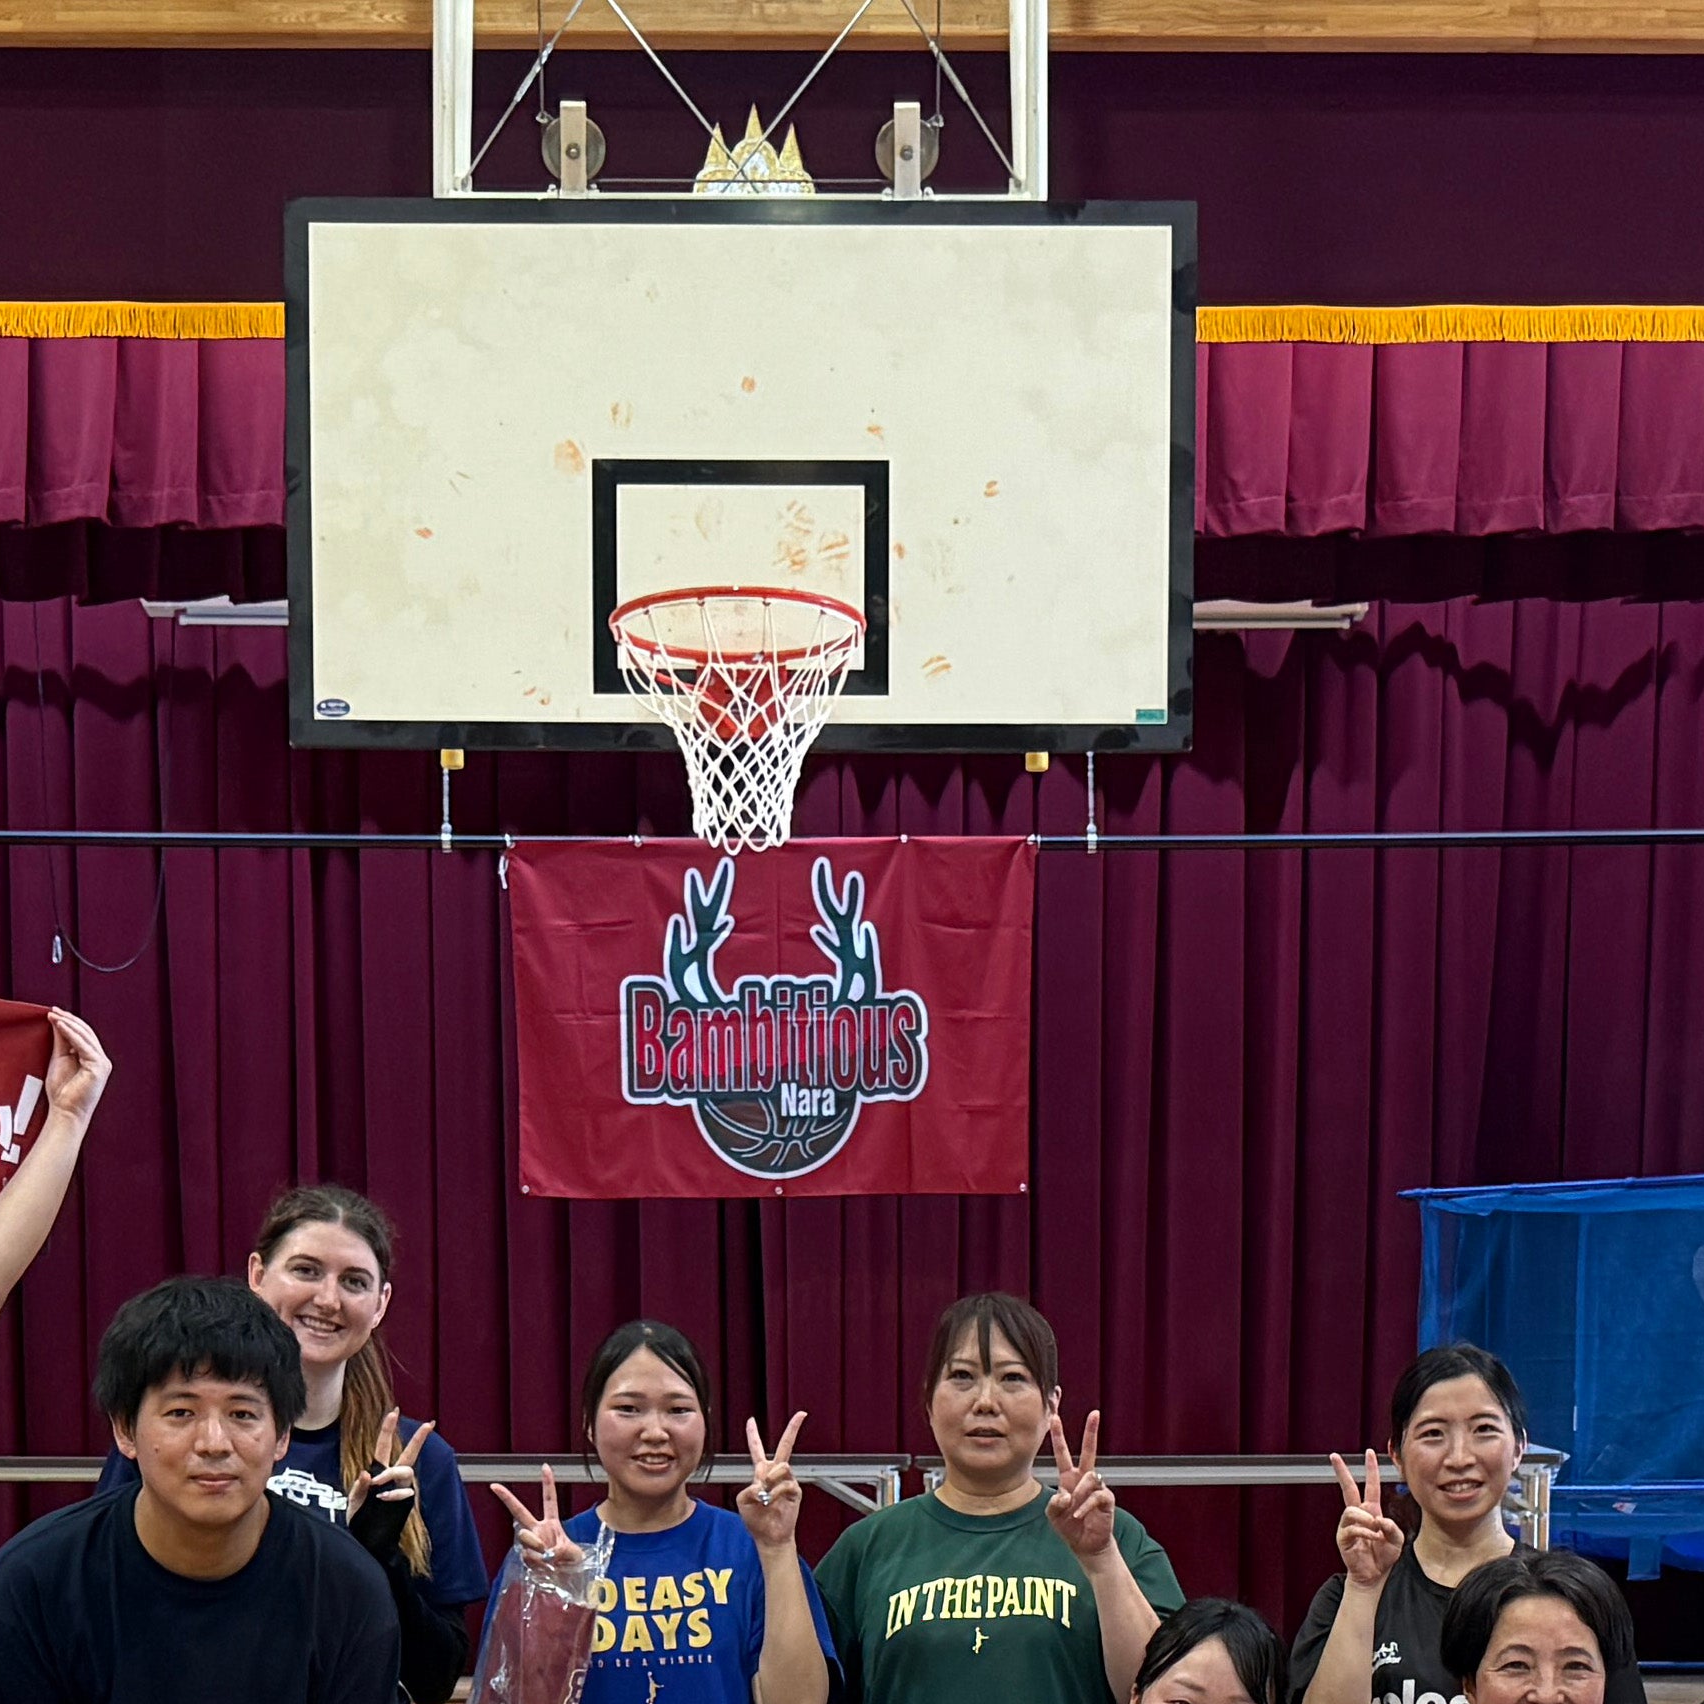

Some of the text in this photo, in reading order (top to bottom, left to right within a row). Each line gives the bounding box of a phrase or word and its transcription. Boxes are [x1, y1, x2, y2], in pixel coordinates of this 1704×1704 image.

[630, 982, 918, 1092] Bambitious
[780, 1082, 837, 1118] Nara
[591, 1608, 713, 1653] DAYS
